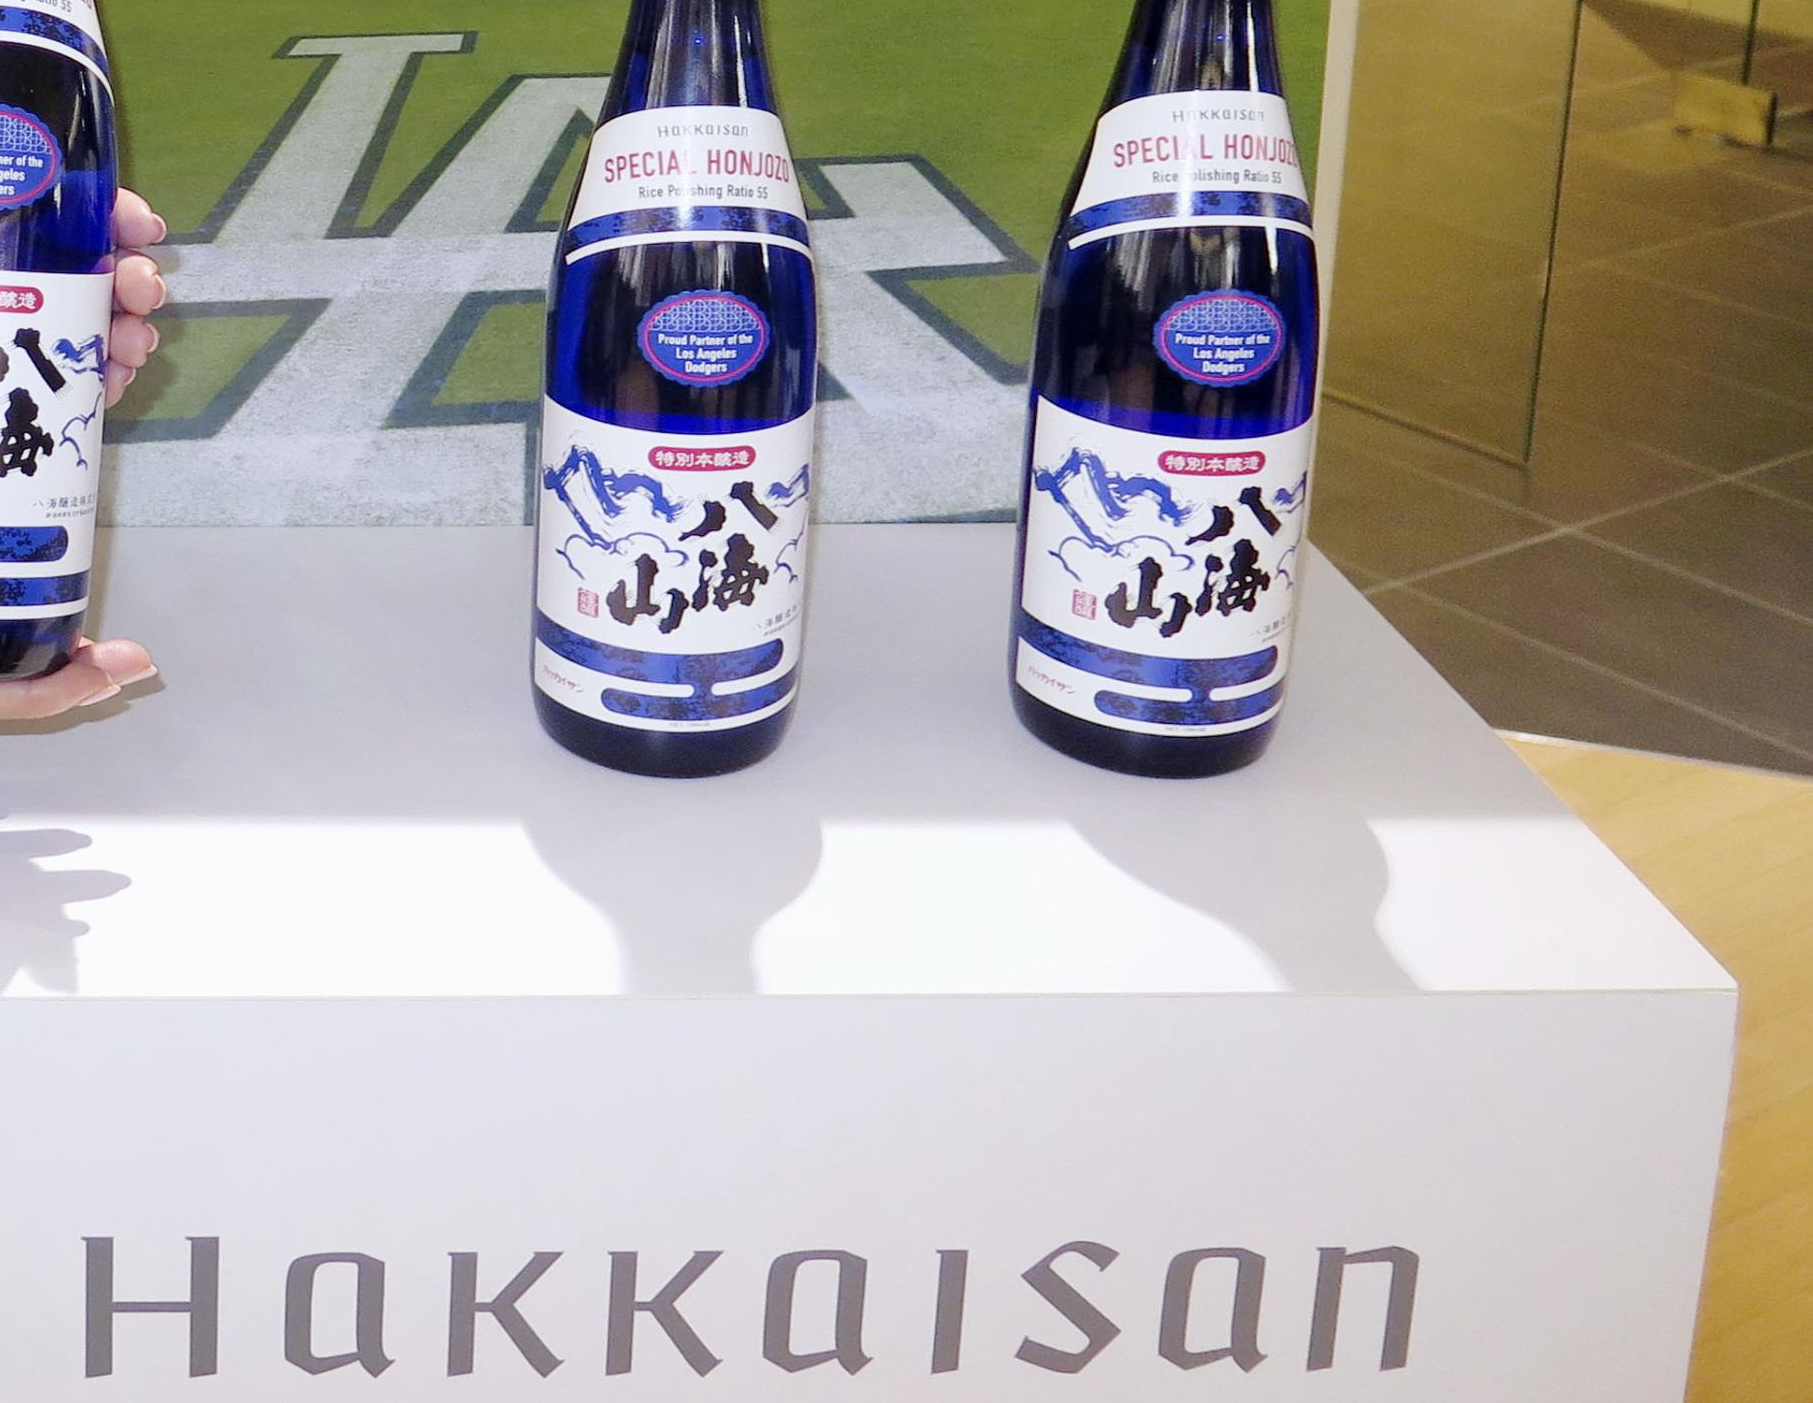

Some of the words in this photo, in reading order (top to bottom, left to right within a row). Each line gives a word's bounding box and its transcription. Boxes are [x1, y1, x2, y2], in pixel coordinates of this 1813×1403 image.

[1113, 133, 1213, 168] SPECIL
[16, 152, 29, 167] of
[29, 154, 44, 168] the
[707, 148, 790, 183] HONJOZO
[1152, 170, 1179, 183] Rice
[1186, 168, 1240, 185] olishing
[638, 186, 663, 199] Rice
[727, 185, 754, 198] Ratio
[757, 187, 768, 199] 55
[658, 333, 687, 345] Proud
[689, 334, 725, 346] Partner
[727, 333, 738, 345] of
[738, 334, 753, 345] the
[1175, 333, 1206, 345] Proud
[1208, 334, 1244, 346] Partner
[1245, 333, 1256, 345] of
[1256, 334, 1270, 345] the
[676, 348, 695, 360] Los
[696, 348, 737, 362] Angeles
[1193, 348, 1213, 360] Los
[1214, 348, 1255, 362] Angeles
[685, 362, 728, 375] Dodgers
[1202, 361, 1245, 375] Dodgers
